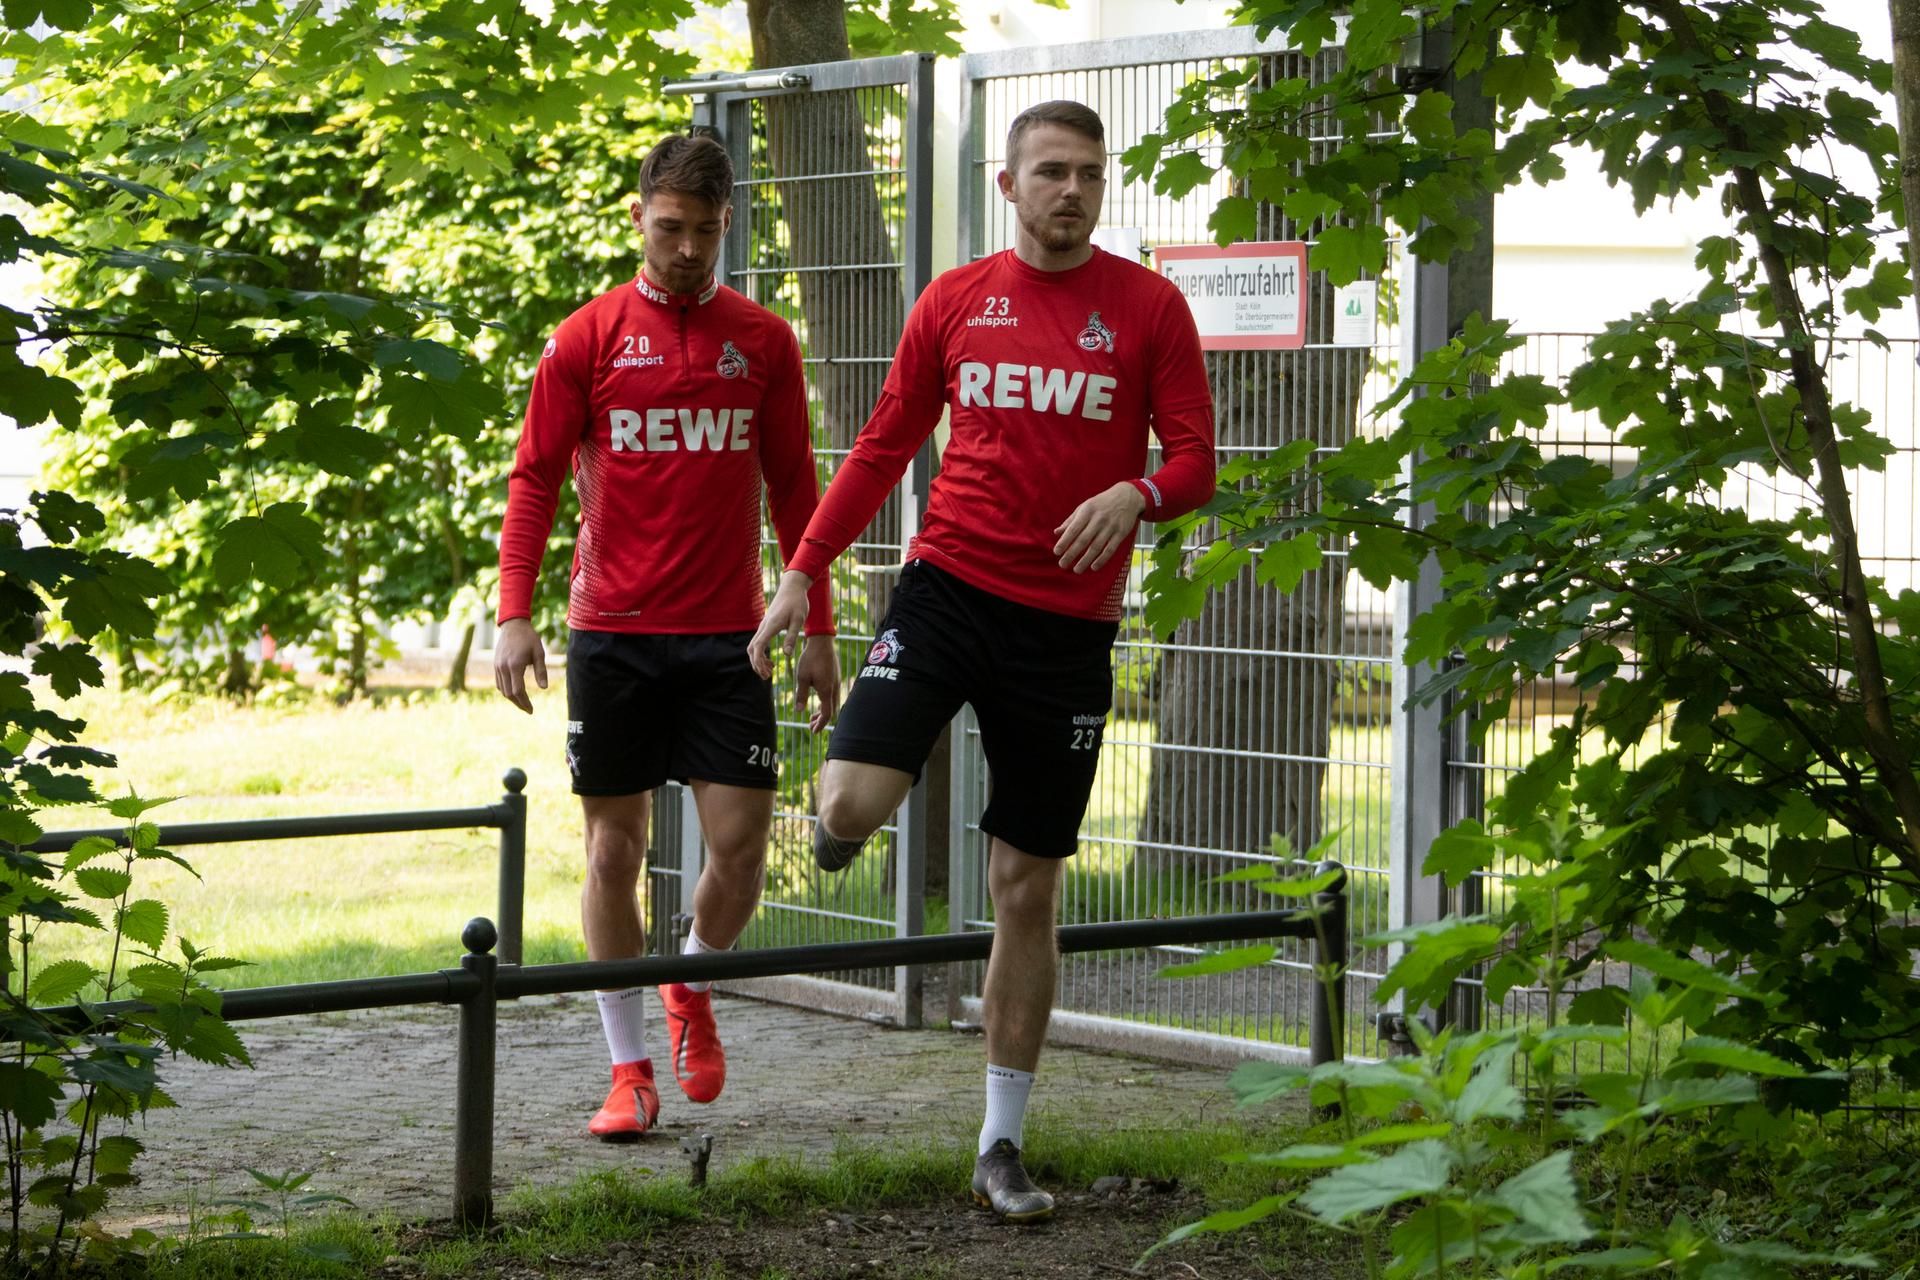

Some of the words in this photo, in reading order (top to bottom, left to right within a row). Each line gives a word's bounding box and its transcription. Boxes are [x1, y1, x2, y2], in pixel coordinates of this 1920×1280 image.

[635, 276, 669, 305] REWE
[984, 296, 1010, 316] 23
[967, 315, 1018, 328] uhlsport
[623, 336, 650, 355] 20
[613, 354, 664, 368] uhlsport
[959, 362, 1117, 421] REWE
[609, 408, 754, 452] REWE
[860, 665, 899, 681] REWE
[567, 720, 584, 734] EWE
[1070, 728, 1095, 750] 23
[747, 744, 770, 768] 20
